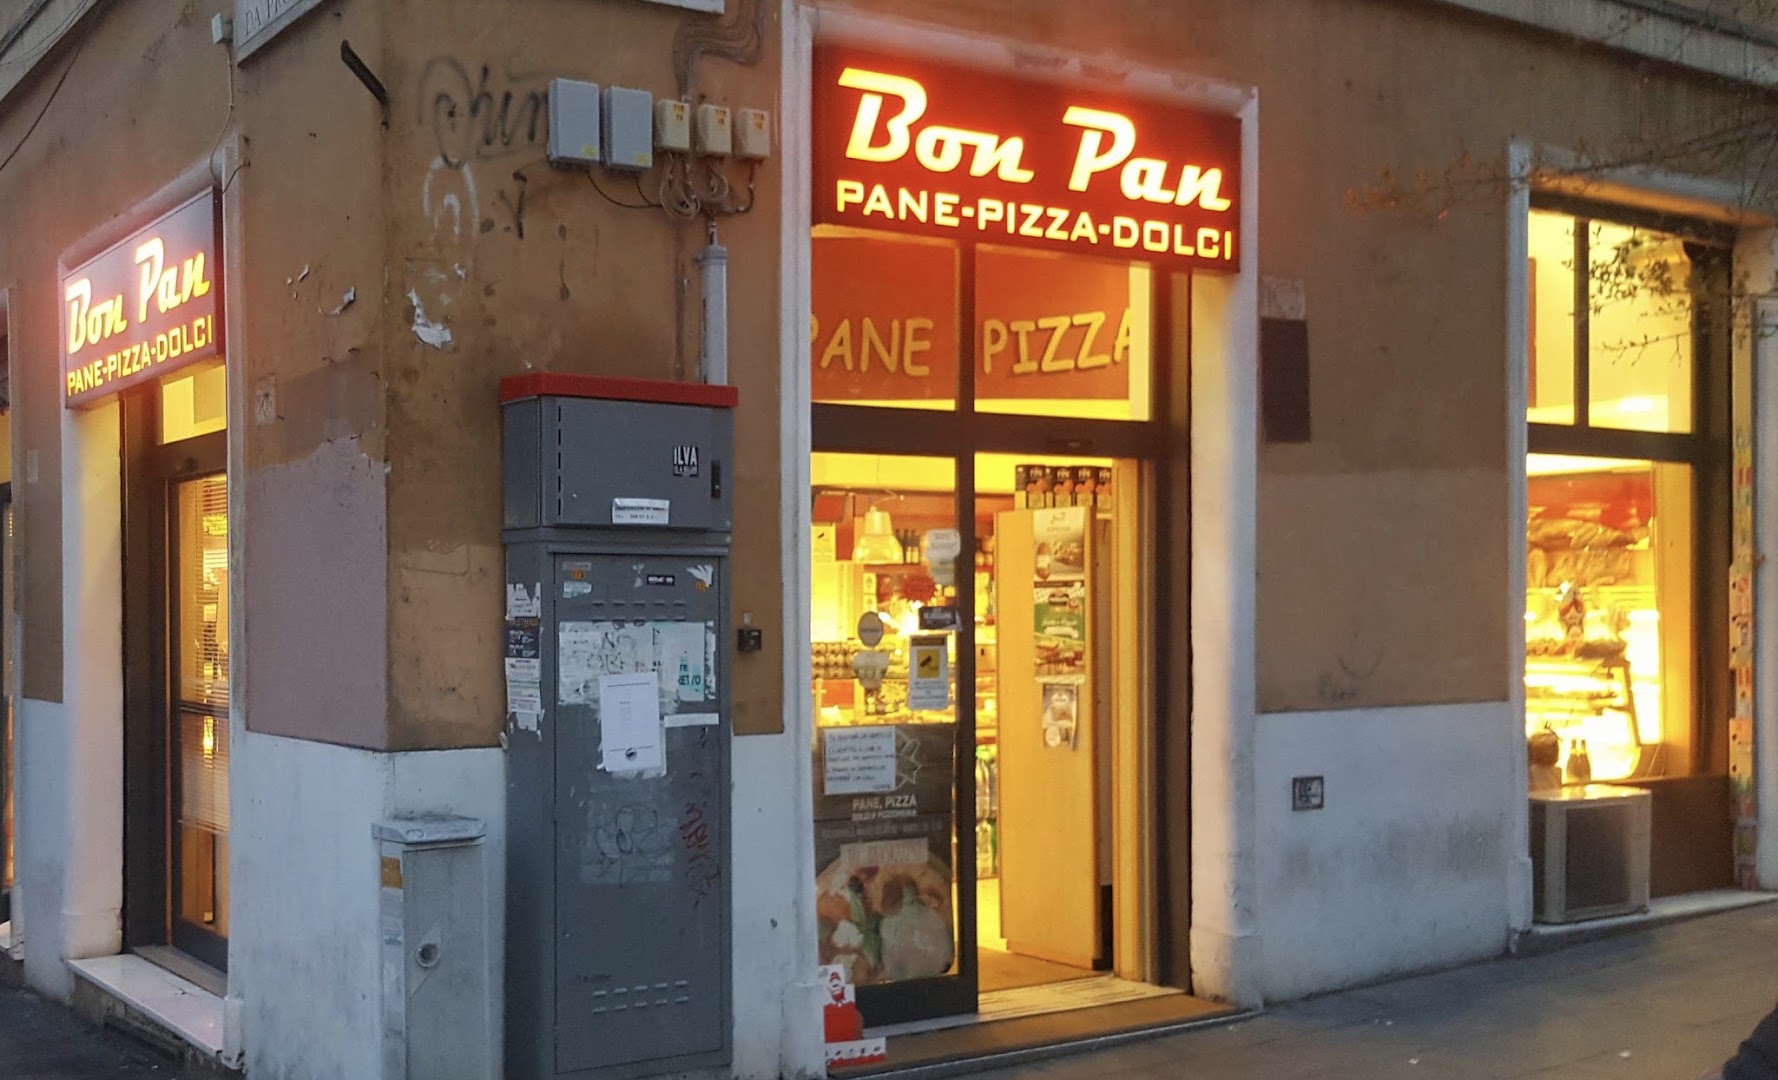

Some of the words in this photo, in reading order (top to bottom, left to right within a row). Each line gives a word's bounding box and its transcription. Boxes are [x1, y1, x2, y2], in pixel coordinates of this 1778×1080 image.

[837, 67, 1035, 183] Bon
[1062, 105, 1231, 211] Pan
[836, 180, 1232, 260] PANE-PIZZA-DOLCI
[66, 278, 128, 354] Bon
[135, 237, 211, 323] Pan
[67, 314, 213, 396] PANE-PIZZA-DOLCI
[673, 446, 698, 465] ILVA
[885, 794, 917, 808] PIZZA
